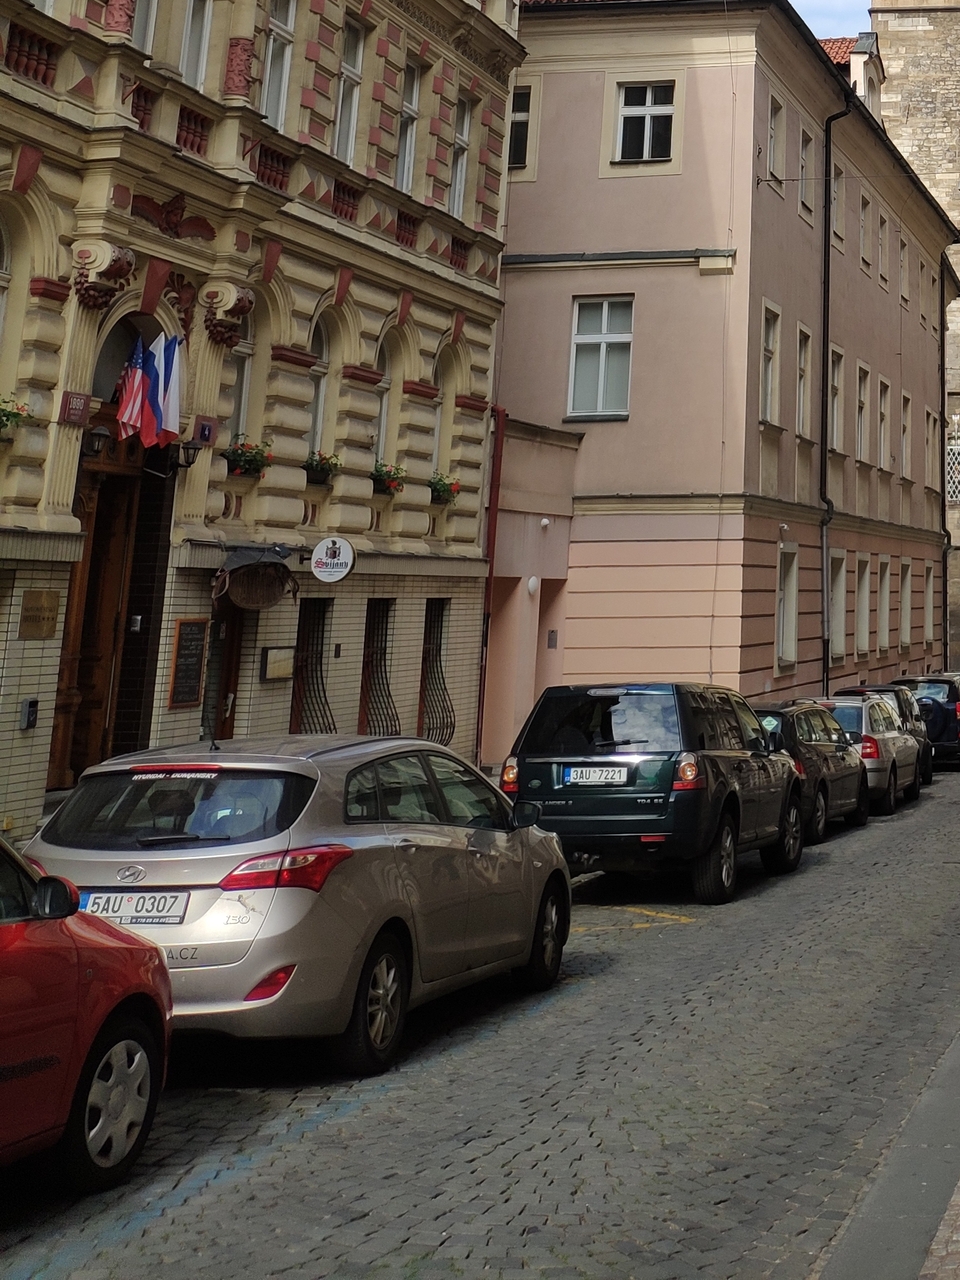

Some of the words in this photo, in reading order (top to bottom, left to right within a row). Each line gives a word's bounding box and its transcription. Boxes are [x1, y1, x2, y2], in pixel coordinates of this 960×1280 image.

[204, 426, 209, 436] 4
[314, 558, 349, 570] Svijany
[573, 769, 591, 780] 3AU
[598, 769, 622, 780] 7221
[91, 895, 124, 914] 5AU
[134, 895, 179, 914] 0307
